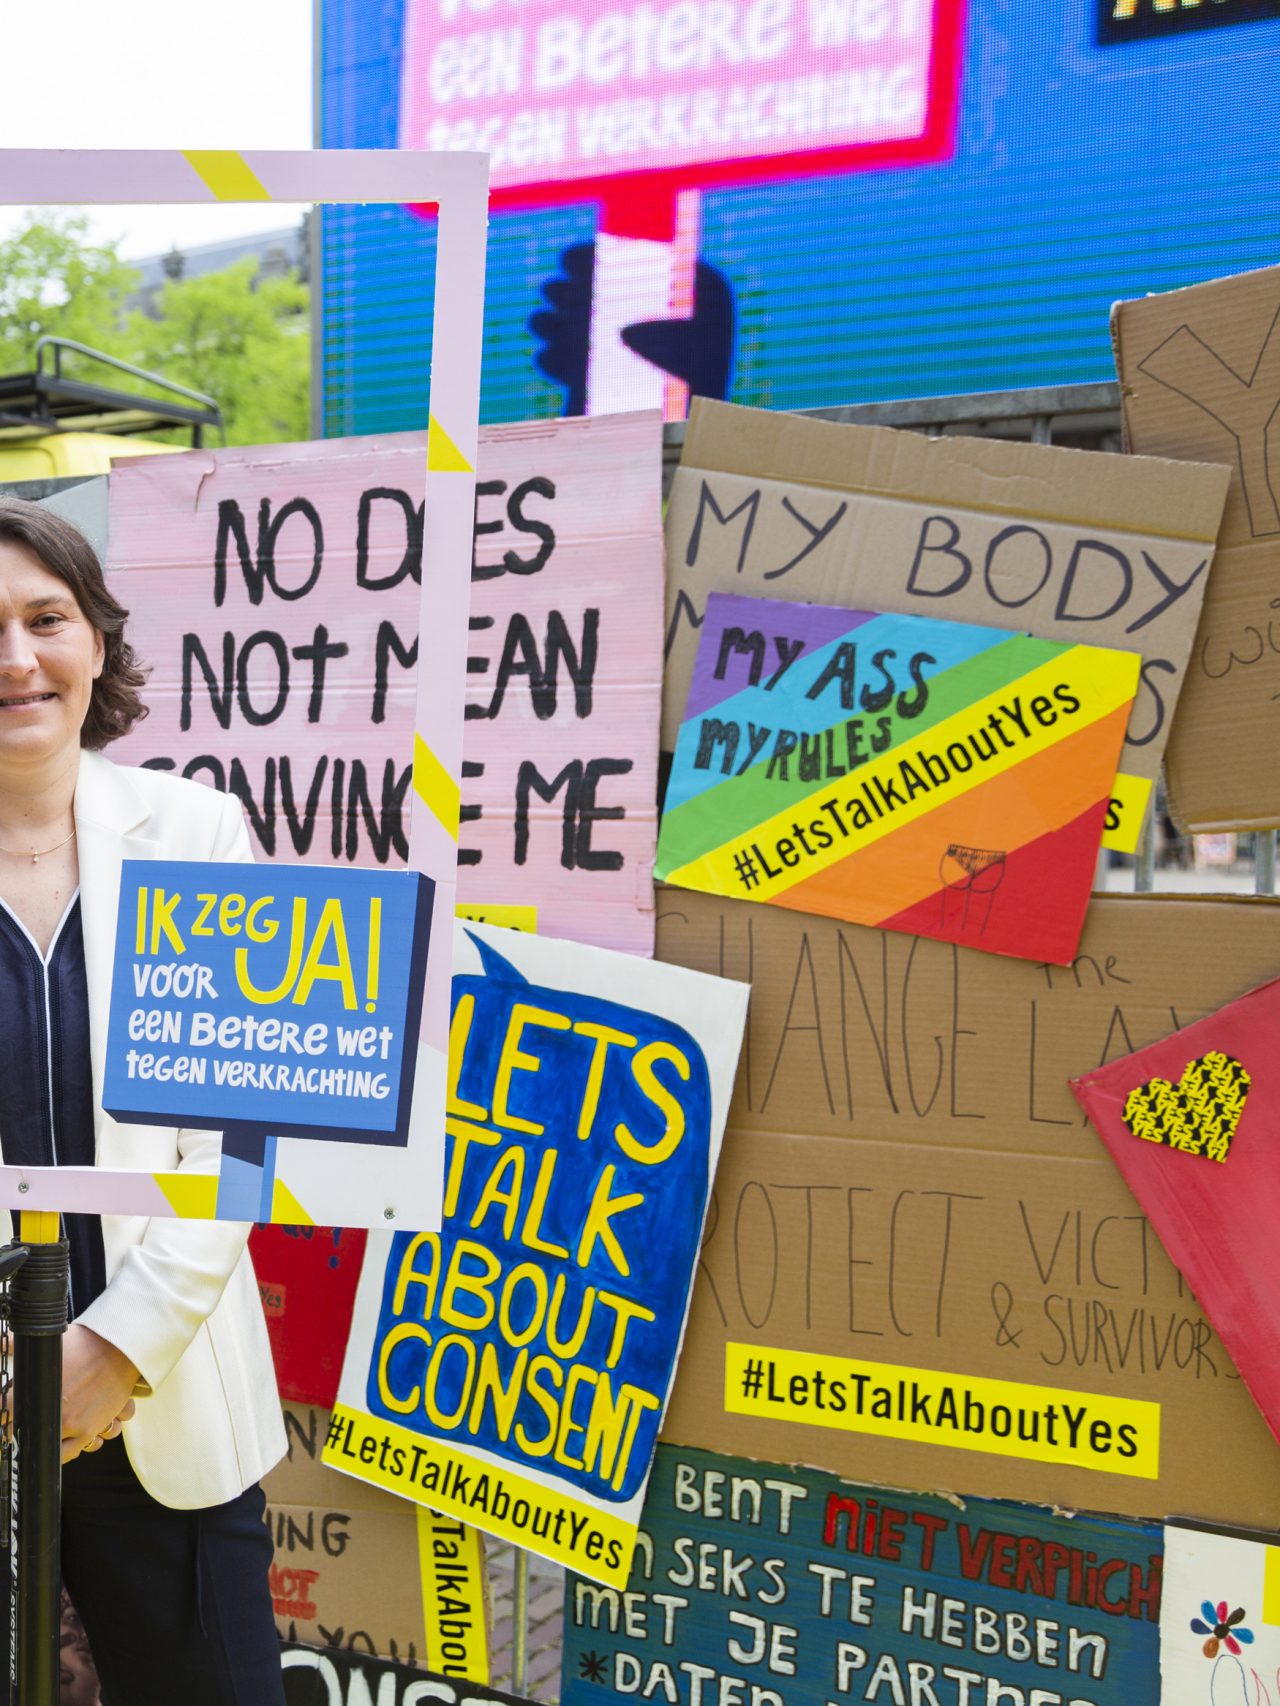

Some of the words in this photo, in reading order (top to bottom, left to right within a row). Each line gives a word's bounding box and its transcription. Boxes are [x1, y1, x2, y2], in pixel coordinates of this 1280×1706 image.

[215, 497, 323, 607] NO
[357, 476, 557, 591] DES
[686, 479, 847, 581] MY
[906, 516, 1208, 635] BODY
[713, 627, 805, 691] MY
[804, 641, 938, 720] ASS
[514, 758, 634, 871] ME
[733, 681, 1080, 890] #LetsTalkAboutYes
[135, 886, 187, 955] IK
[234, 897, 382, 1014] JA!
[656, 912, 985, 1121] HANGE
[447, 992, 690, 1165] LETS
[445, 1116, 646, 1277] TALK
[392, 1231, 655, 1368] ABOUT
[378, 1321, 660, 1492] CONSENT
[742, 1358, 1139, 1458] #LetsTalkAboutYes
[324, 1412, 625, 1569] #LetsTalkAboutYes
[667, 1537, 786, 1605] SEKS
[808, 1563, 876, 1625] TE
[727, 1610, 798, 1676] JE
